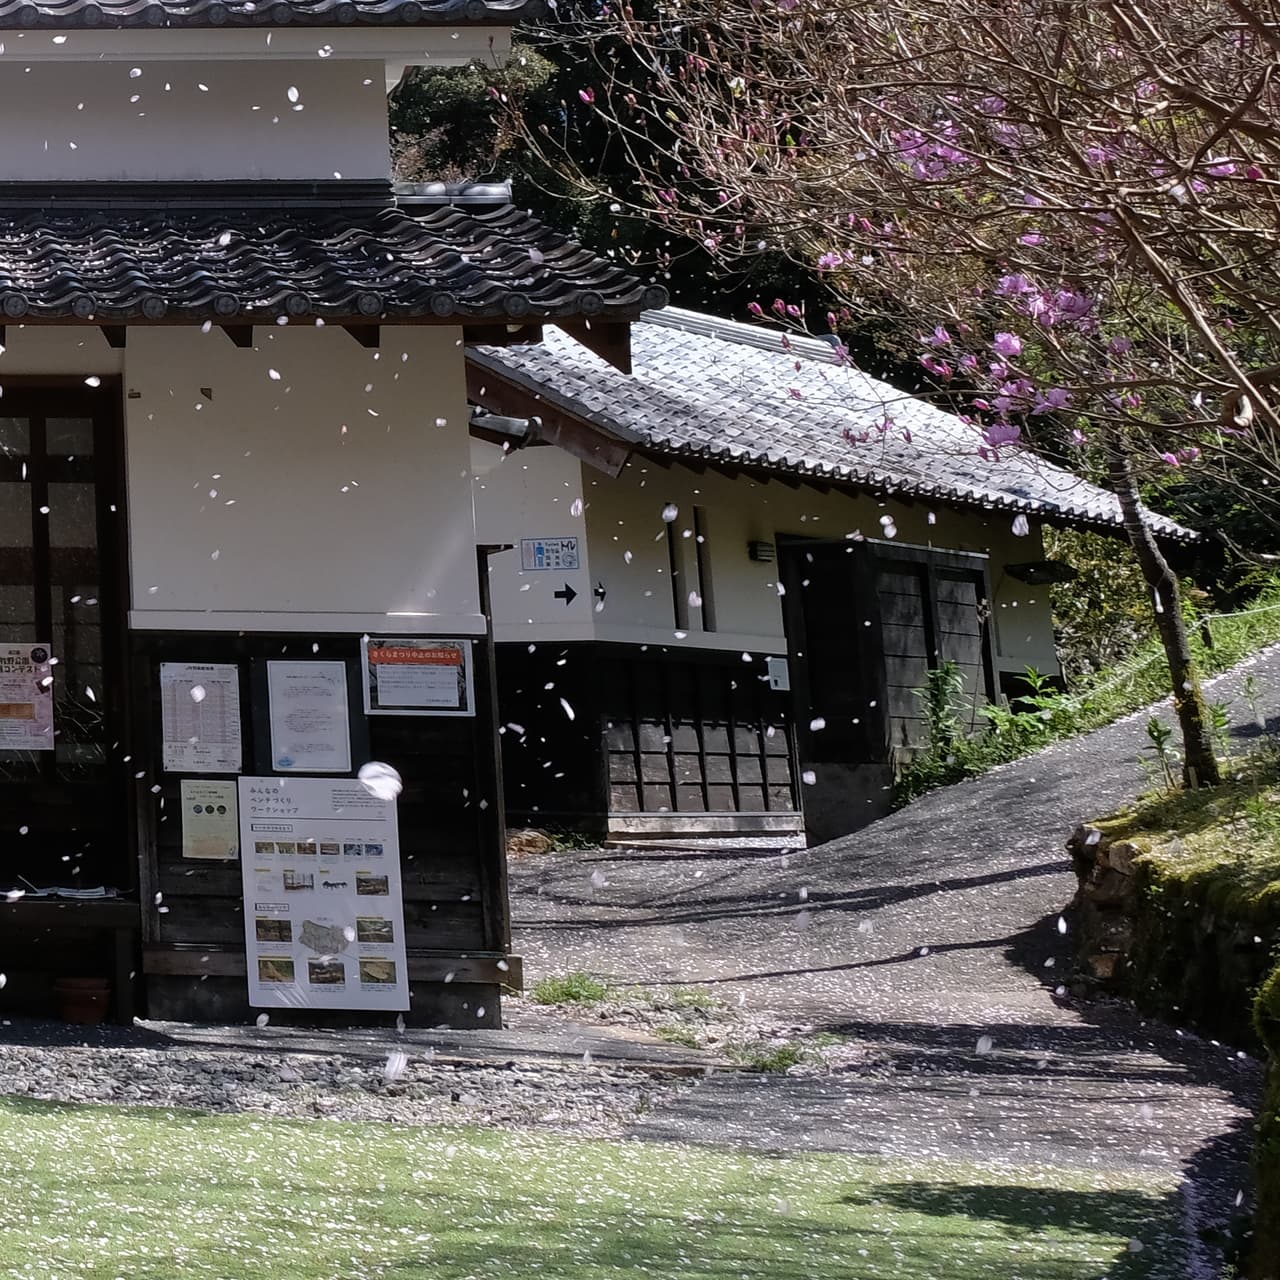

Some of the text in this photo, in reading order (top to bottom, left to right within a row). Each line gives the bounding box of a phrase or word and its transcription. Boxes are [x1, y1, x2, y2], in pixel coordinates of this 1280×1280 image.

[372, 650, 458, 659] さくらまつり中止のお知らせ
[249, 786, 279, 794] みんなの
[249, 796, 292, 805] ベンチづくり
[250, 806, 300, 814] ワークショップ
